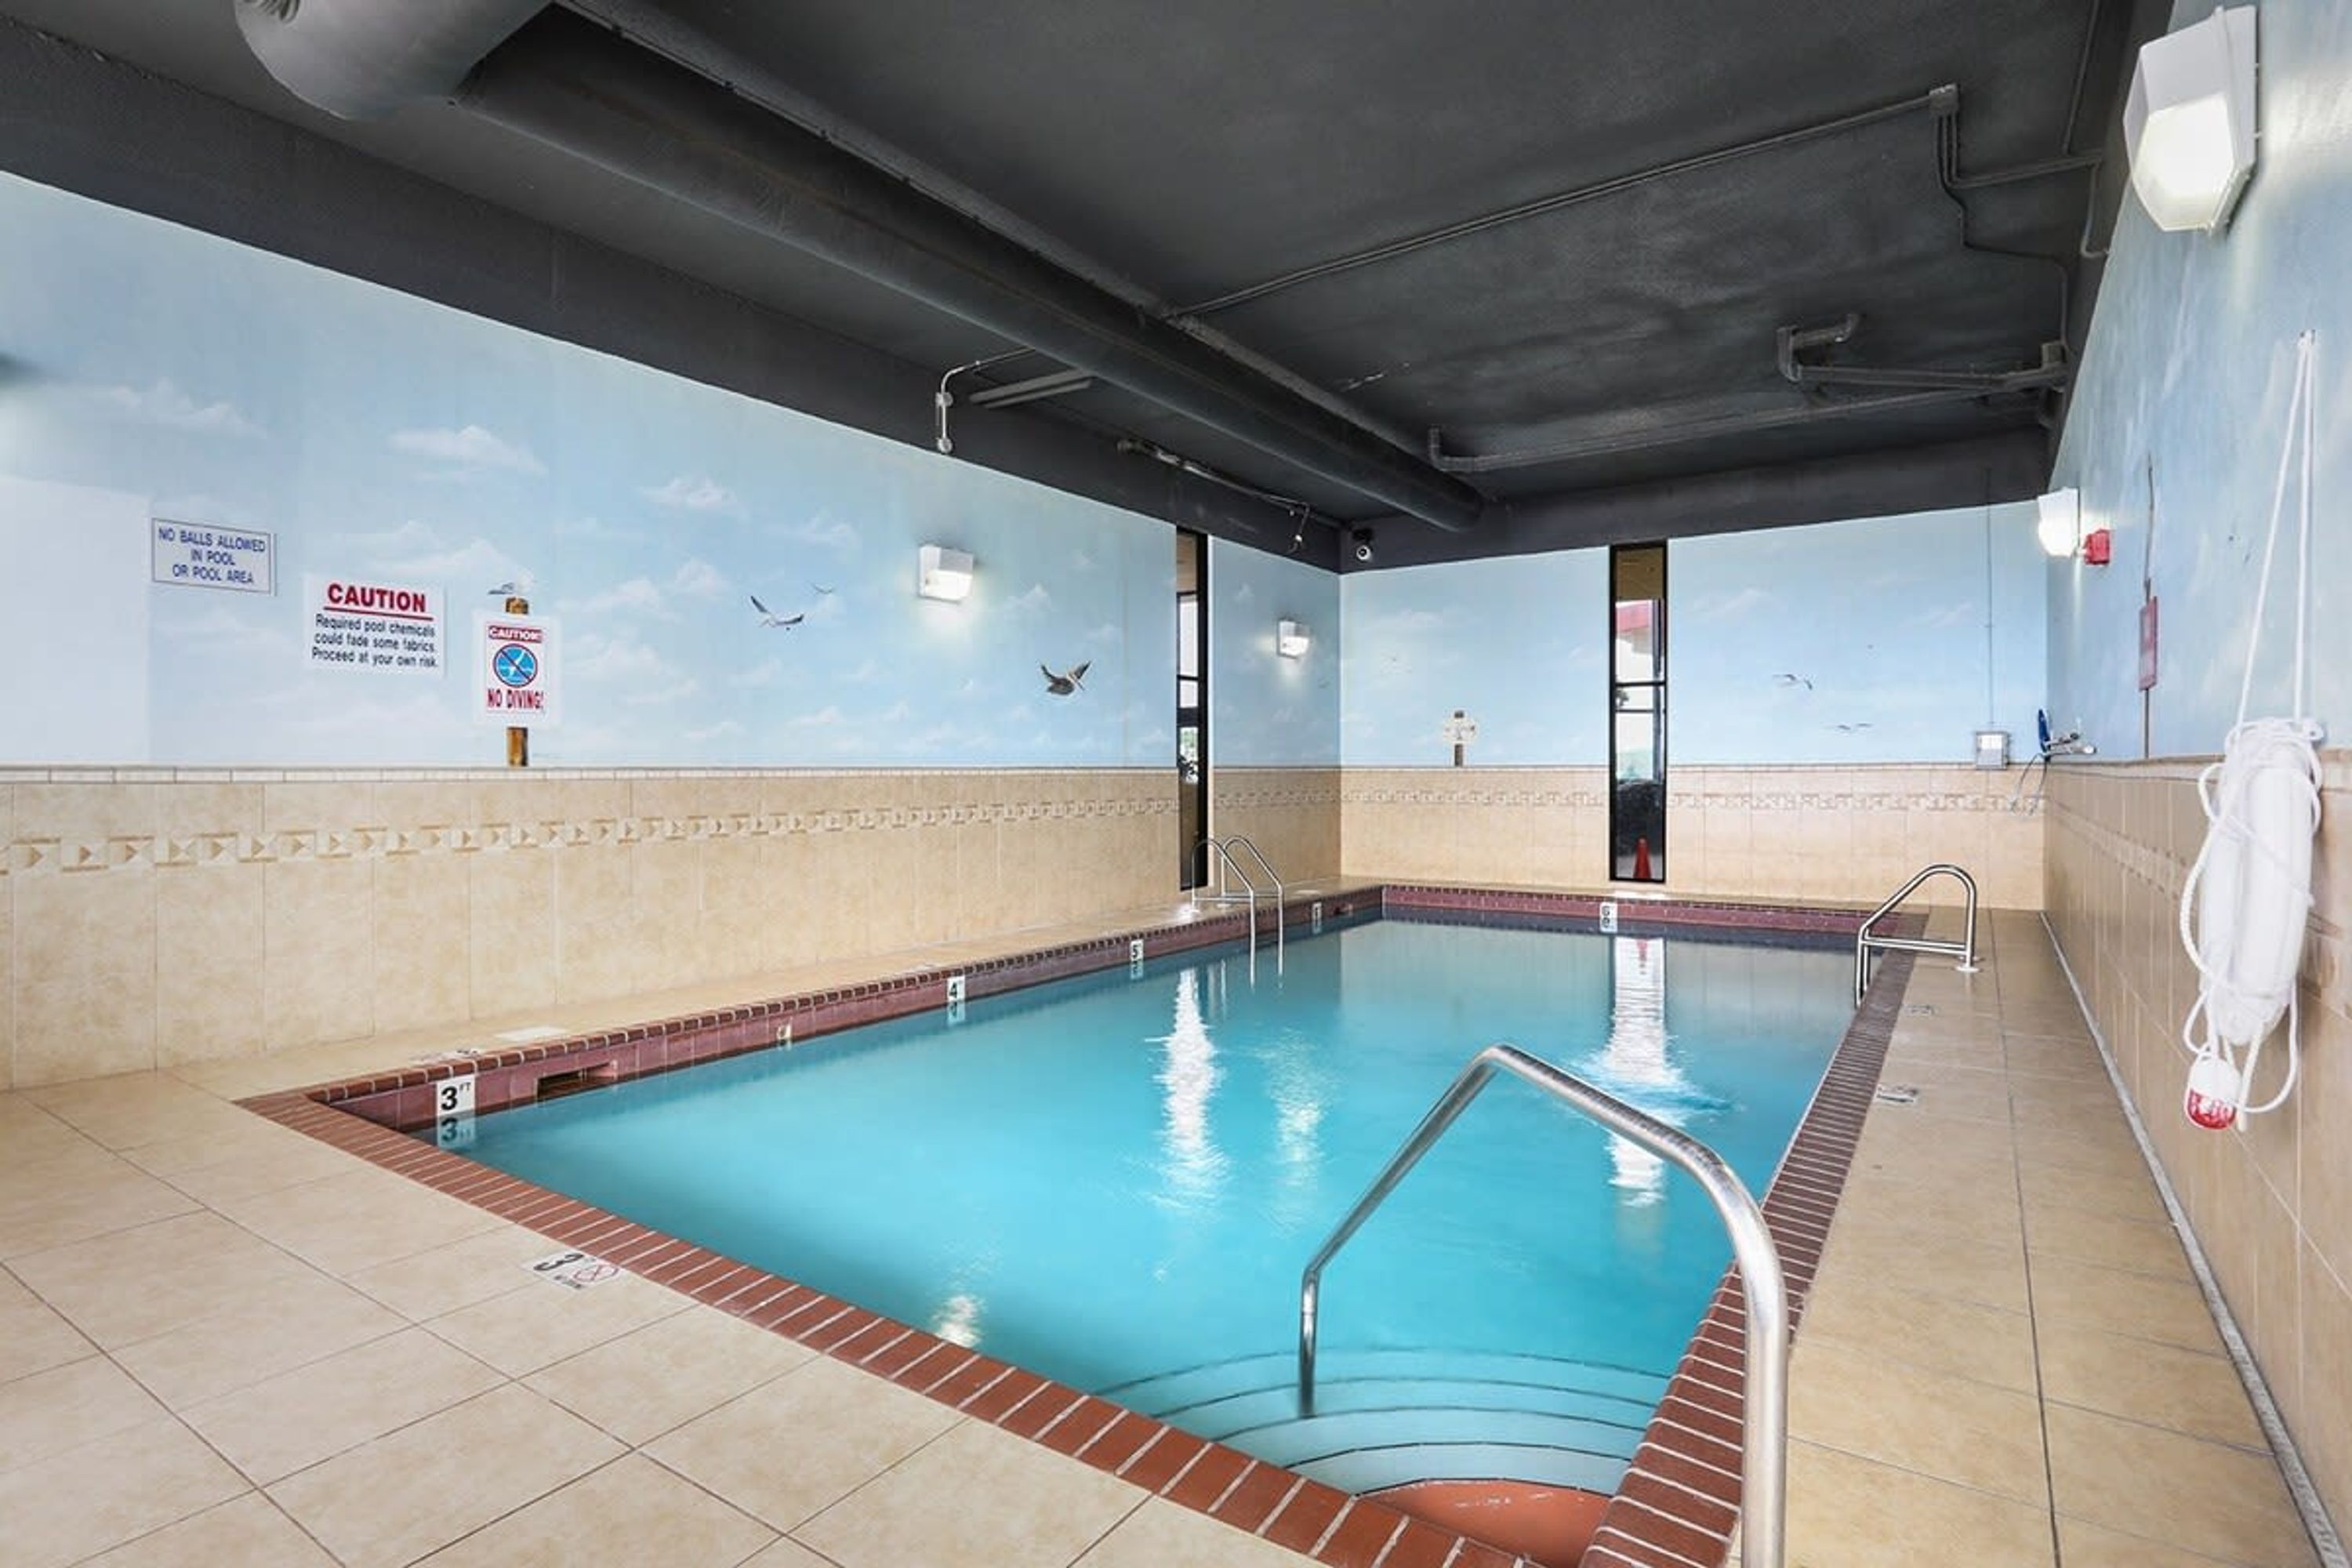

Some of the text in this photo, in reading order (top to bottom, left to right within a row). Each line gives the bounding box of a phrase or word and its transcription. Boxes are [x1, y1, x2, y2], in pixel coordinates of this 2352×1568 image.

[158, 528, 266, 552] NO BALLS ALLOWED
[191, 550, 235, 565] IN POOL
[172, 564, 254, 583] OR POOL AREA
[328, 583, 426, 612] CAUTION
[315, 613, 435, 637] Required pool chemicals
[314, 633, 343, 645] could
[347, 634, 368, 647] fade
[373, 639, 399, 650] some
[311, 647, 355, 662] Proceed
[358, 652, 369, 663] at
[372, 655, 393, 666] your
[397, 656, 416, 666] own
[488, 689, 544, 709] NO DIVING!
[1132, 944, 1138, 959] 5
[949, 982, 957, 999] 4
[441, 1082, 471, 1110] 3 FT
[533, 1253, 583, 1271] 3
